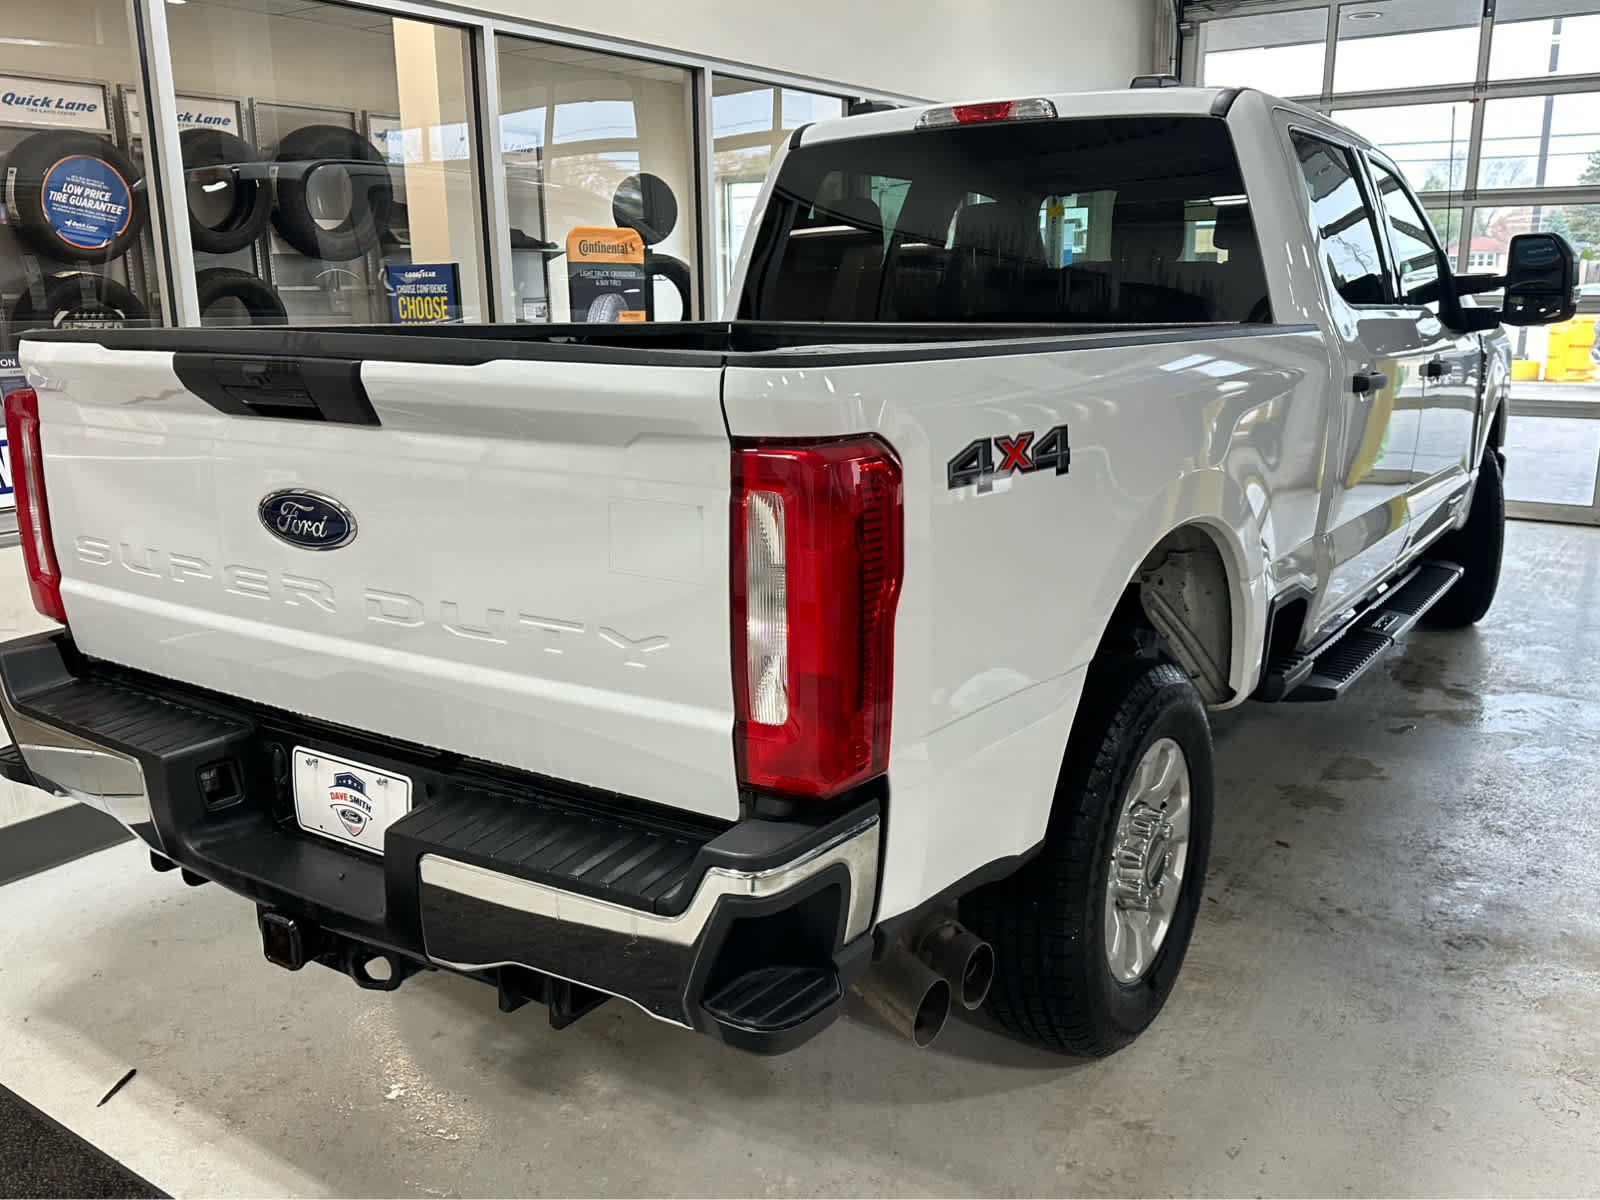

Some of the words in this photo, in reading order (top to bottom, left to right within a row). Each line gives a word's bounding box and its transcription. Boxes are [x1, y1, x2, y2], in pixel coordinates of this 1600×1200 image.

[1, 92, 53, 108] Quick
[54, 97, 98, 112] Lane
[195, 113, 231, 126] Lane
[62, 182, 84, 196] LOW
[84, 187, 112, 202] PRICE
[49, 190, 69, 204] TIRE
[69, 195, 126, 215] GUARANTEE
[579, 240, 629, 256] Continental
[404, 269, 436, 278] GOODYEAR
[416, 283, 449, 294] CONFIDENCE
[398, 295, 449, 320] CHOOSE
[276, 501, 328, 538] Ford
[74, 534, 337, 614] SUPER
[363, 586, 671, 669] DUTY
[329, 791, 348, 801] DAVE
[349, 794, 372, 813] SMITH
